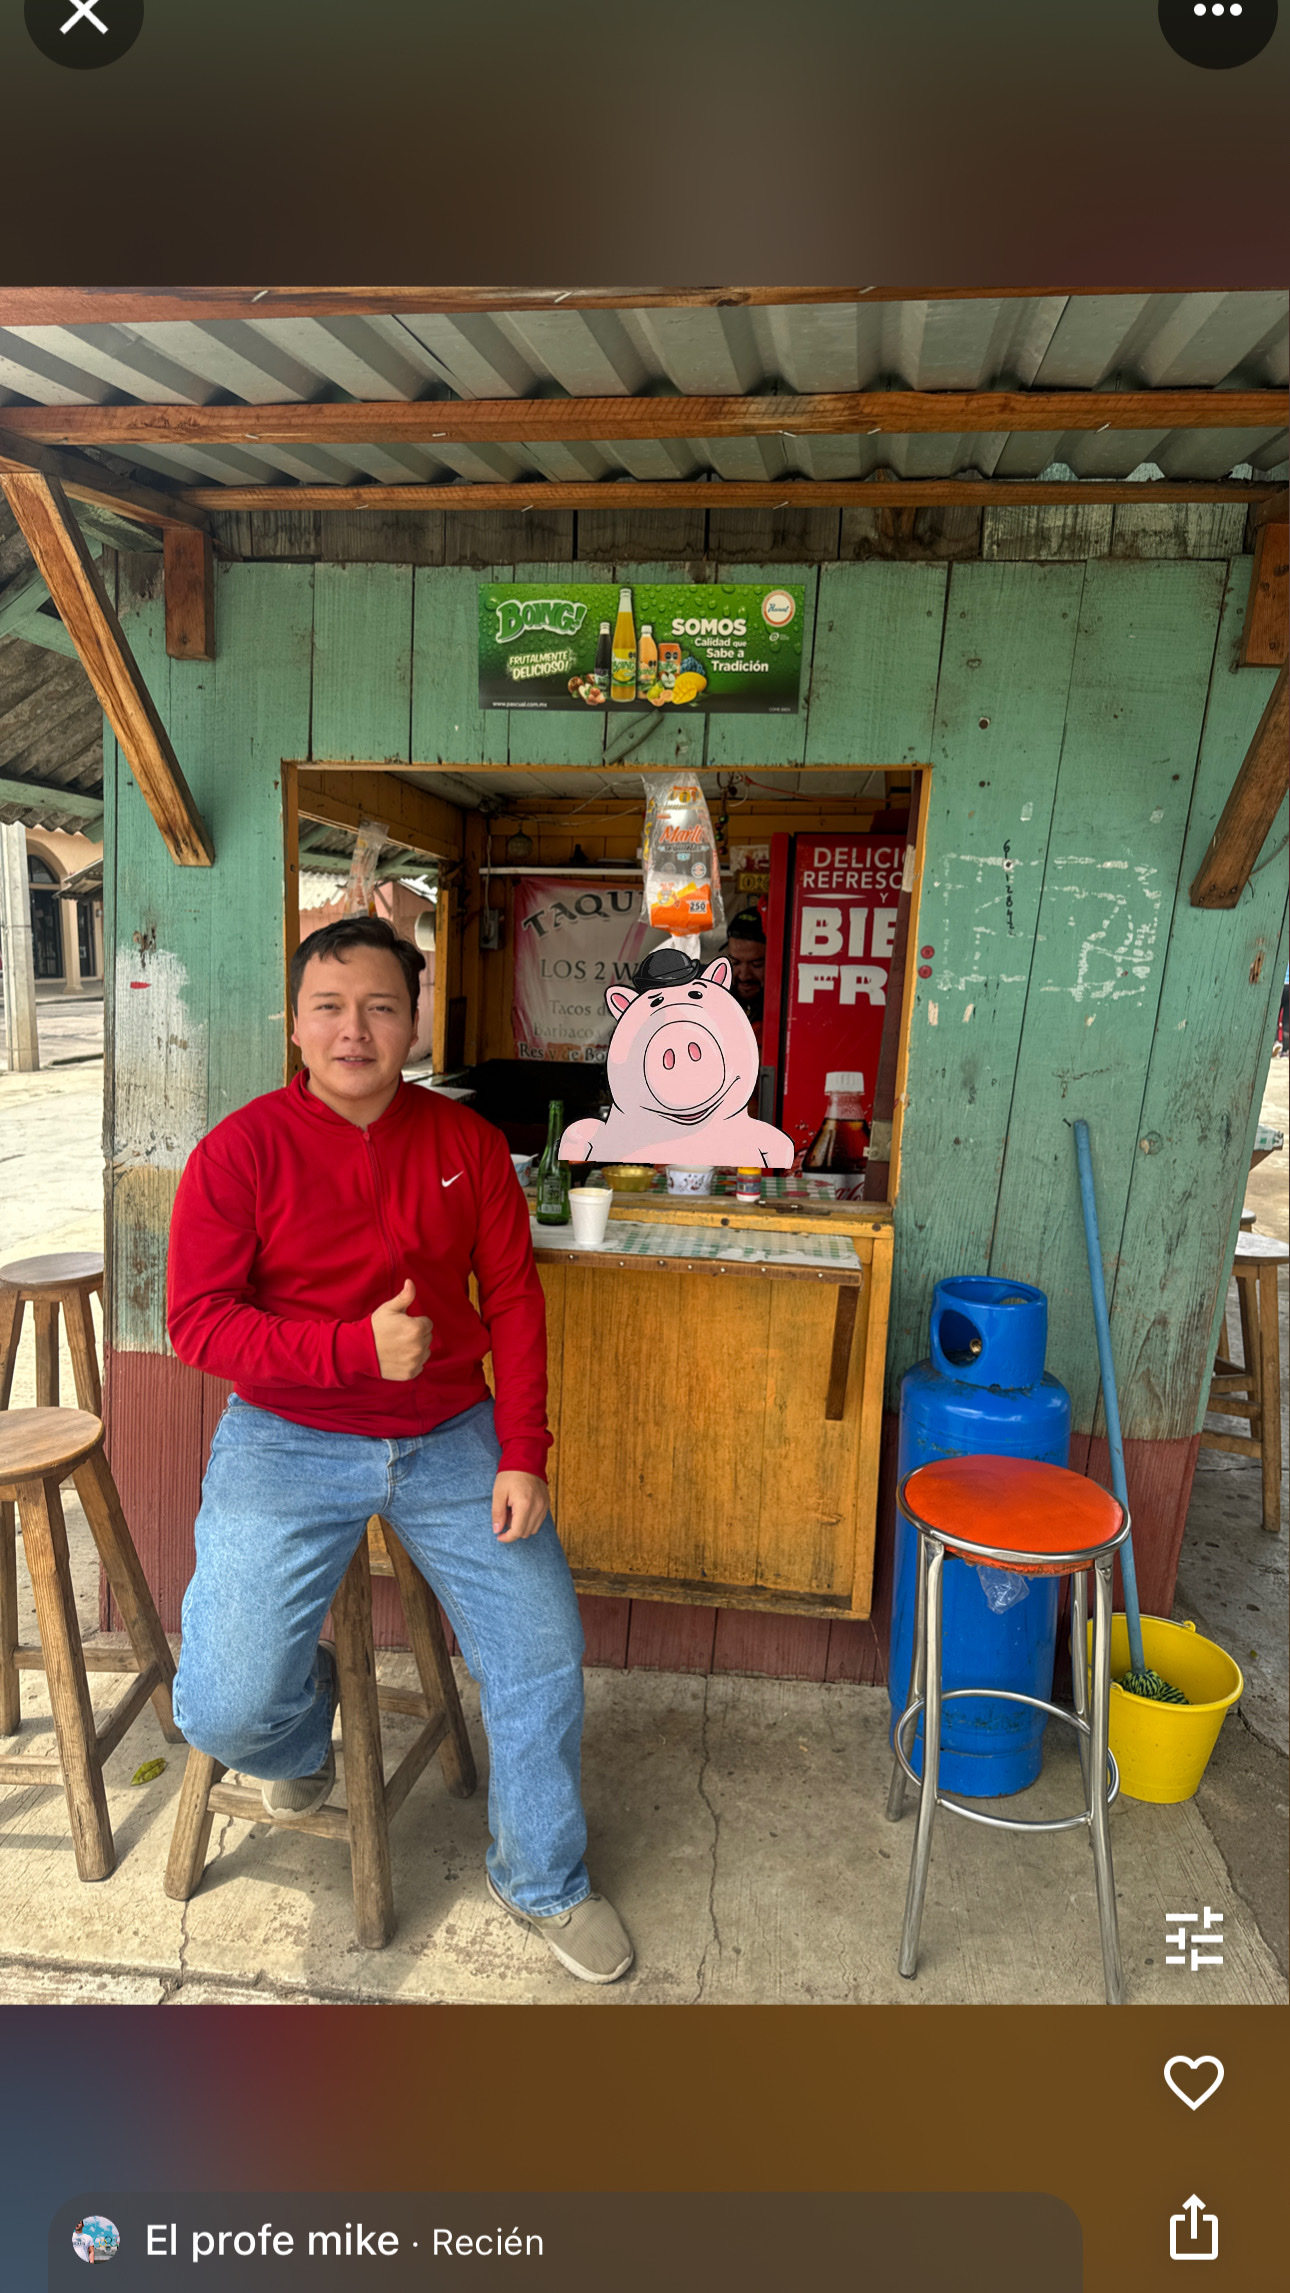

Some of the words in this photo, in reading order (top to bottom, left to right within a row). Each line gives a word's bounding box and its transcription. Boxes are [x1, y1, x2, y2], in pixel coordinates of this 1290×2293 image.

[496, 600, 587, 643] BOING!
[671, 618, 747, 636] SOMOS
[694, 638, 731, 647] Calidad
[509, 650, 568, 666] FRUTALMENTE
[706, 648, 735, 658] Sabe
[737, 650, 745, 658] a
[512, 661, 570, 681] DELICIOSO!
[711, 660, 769, 672] Tradición
[814, 847, 905, 868] DELICI
[879, 893, 889, 903] Y
[523, 890, 643, 938] TAQU
[690, 902, 706, 912] 250
[540, 959, 587, 980] LOS
[594, 961, 605, 980] 2
[550, 999, 591, 1015] Tacos
[520, 1043, 544, 1058] Res
[561, 1046, 580, 1060] de
